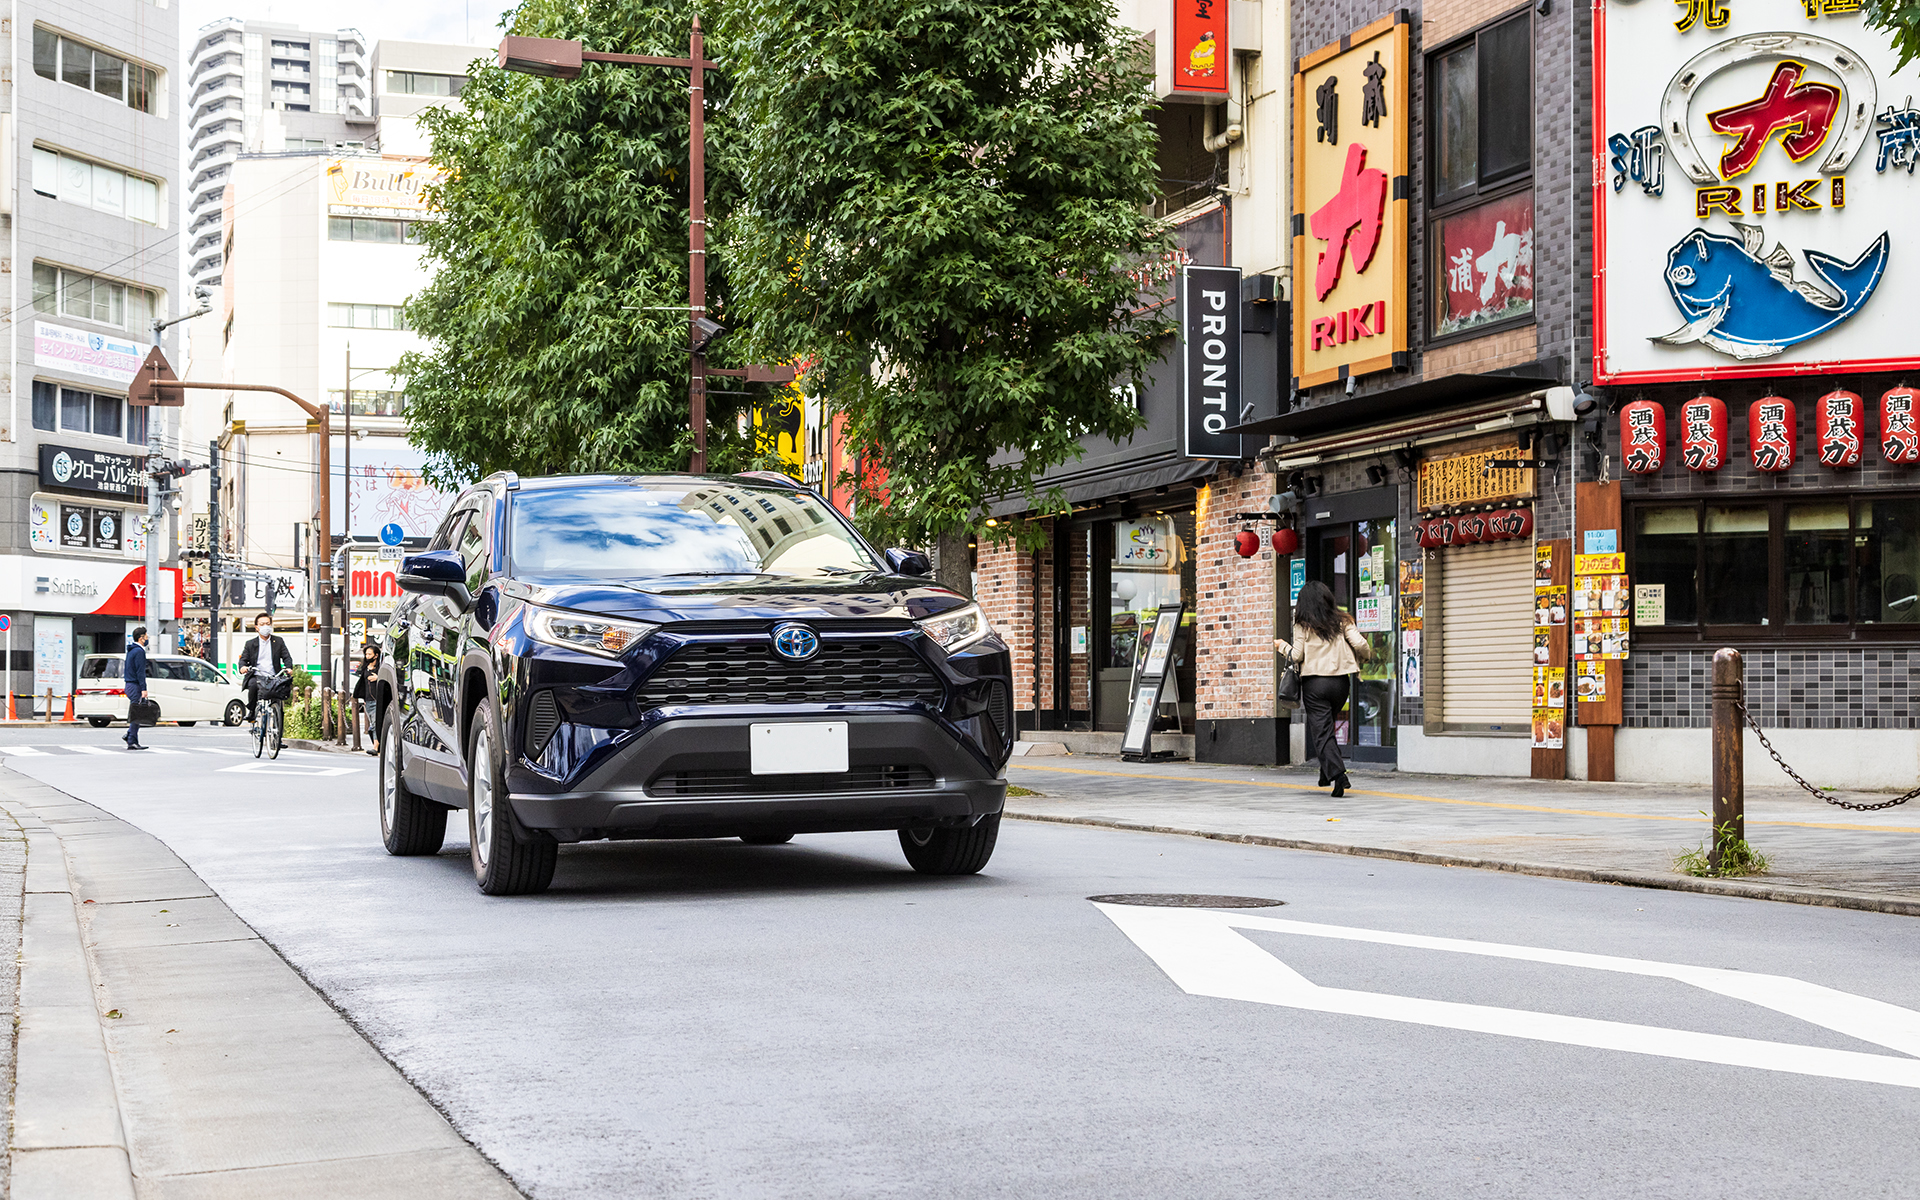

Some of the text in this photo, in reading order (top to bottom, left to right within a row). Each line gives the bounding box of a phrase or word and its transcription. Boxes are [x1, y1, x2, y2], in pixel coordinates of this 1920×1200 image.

[1707, 60, 1842, 182] 力
[1695, 175, 1846, 219] RIKI
[1310, 143, 1388, 303] 力
[1310, 300, 1386, 351] RIKI
[1202, 289, 1227, 434] PRONTO
[52, 577, 99, 596] SoftBank
[1580, 556, 1621, 571] 力の定食
